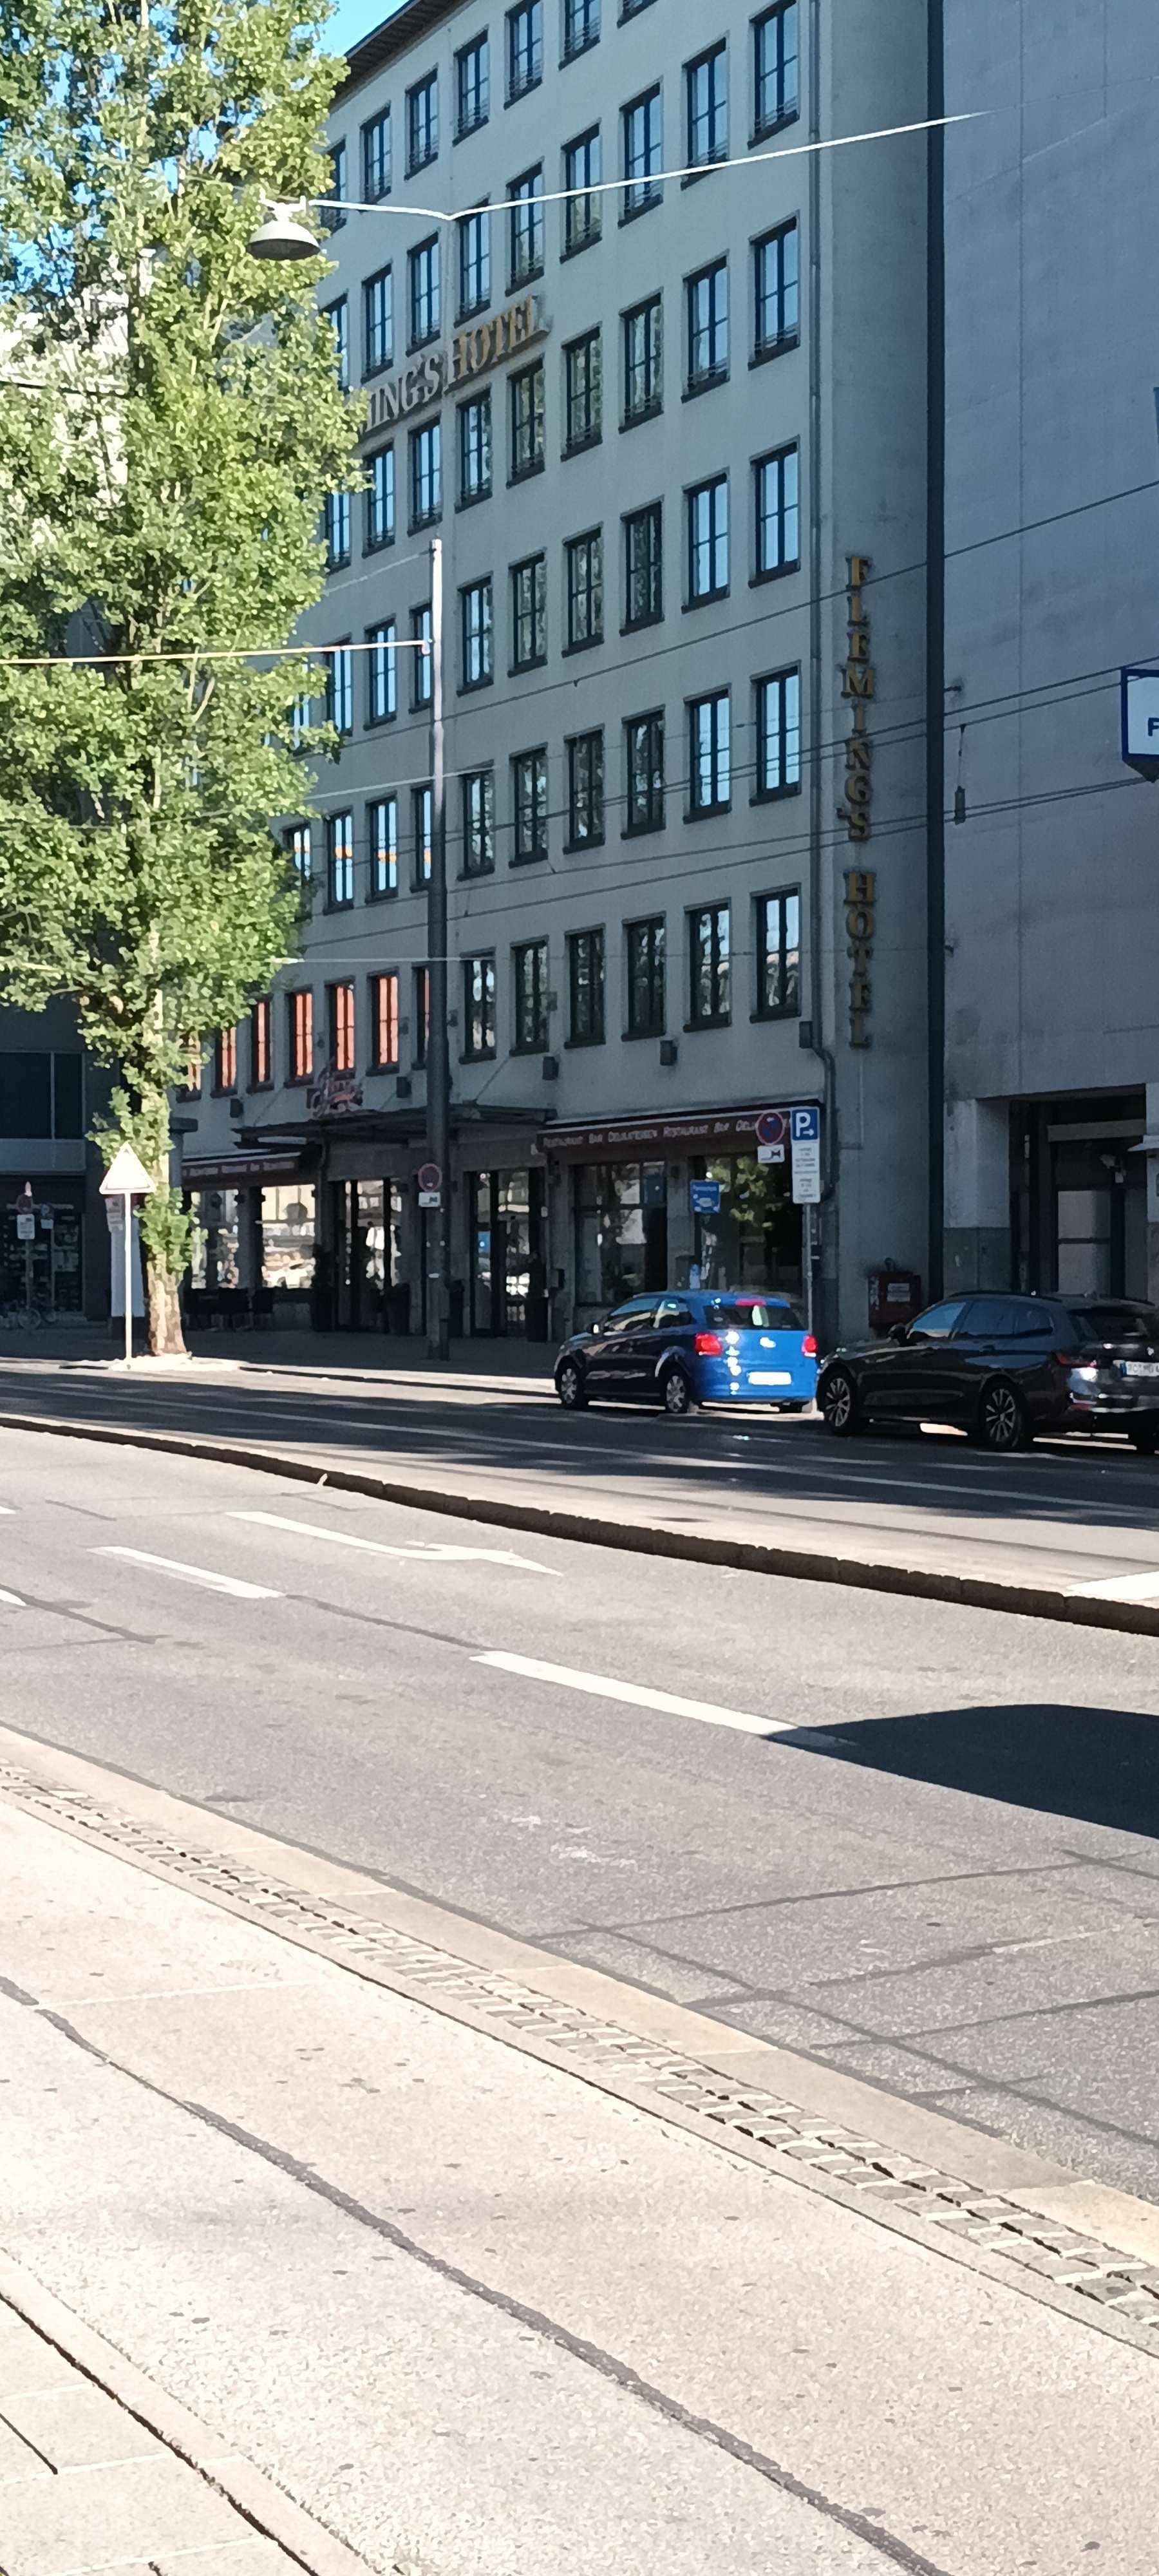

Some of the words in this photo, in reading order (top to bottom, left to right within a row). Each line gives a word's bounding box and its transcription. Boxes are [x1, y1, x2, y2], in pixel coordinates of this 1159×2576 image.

[364, 354, 440, 433] ING'S
[443, 295, 552, 392] HOTEL
[838, 556, 875, 842] FLEMING'S
[843, 871, 876, 1048] HOTEL
[796, 1112, 811, 1137] P
